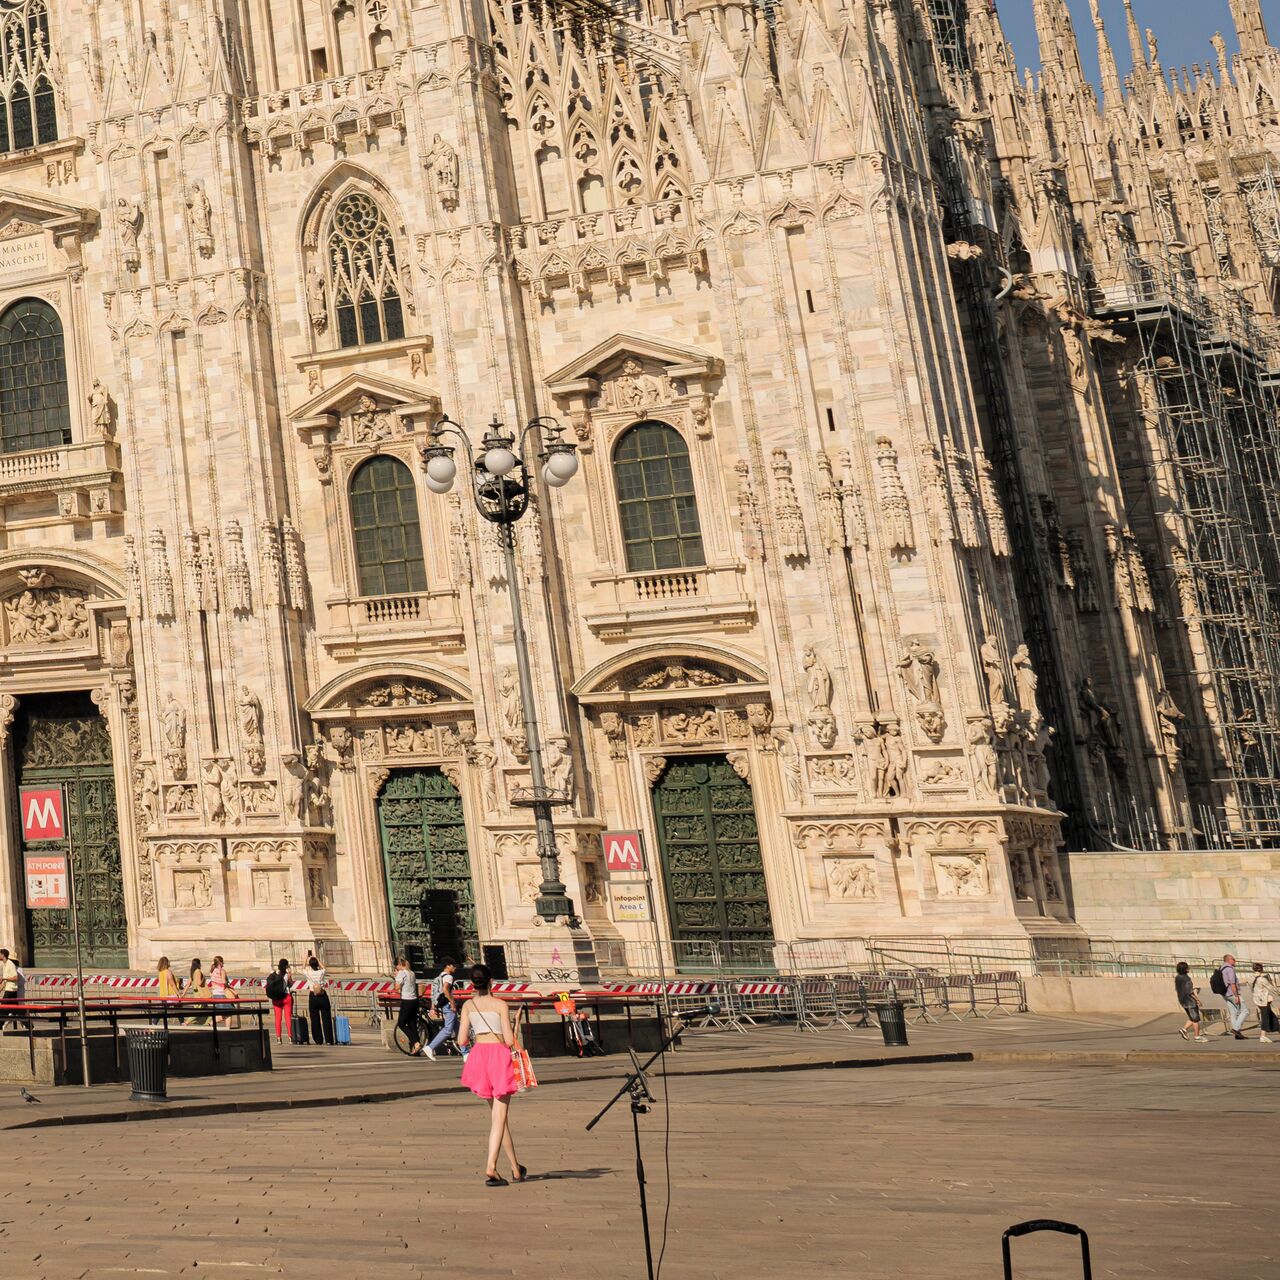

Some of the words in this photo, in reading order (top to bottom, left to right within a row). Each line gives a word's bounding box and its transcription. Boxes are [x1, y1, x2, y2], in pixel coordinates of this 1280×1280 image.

[2, 241, 39, 254] MARIAE
[0, 253, 45, 268] NASCENTI
[26, 798, 61, 829] M
[608, 840, 640, 863] M
[27, 862, 41, 870] ATM
